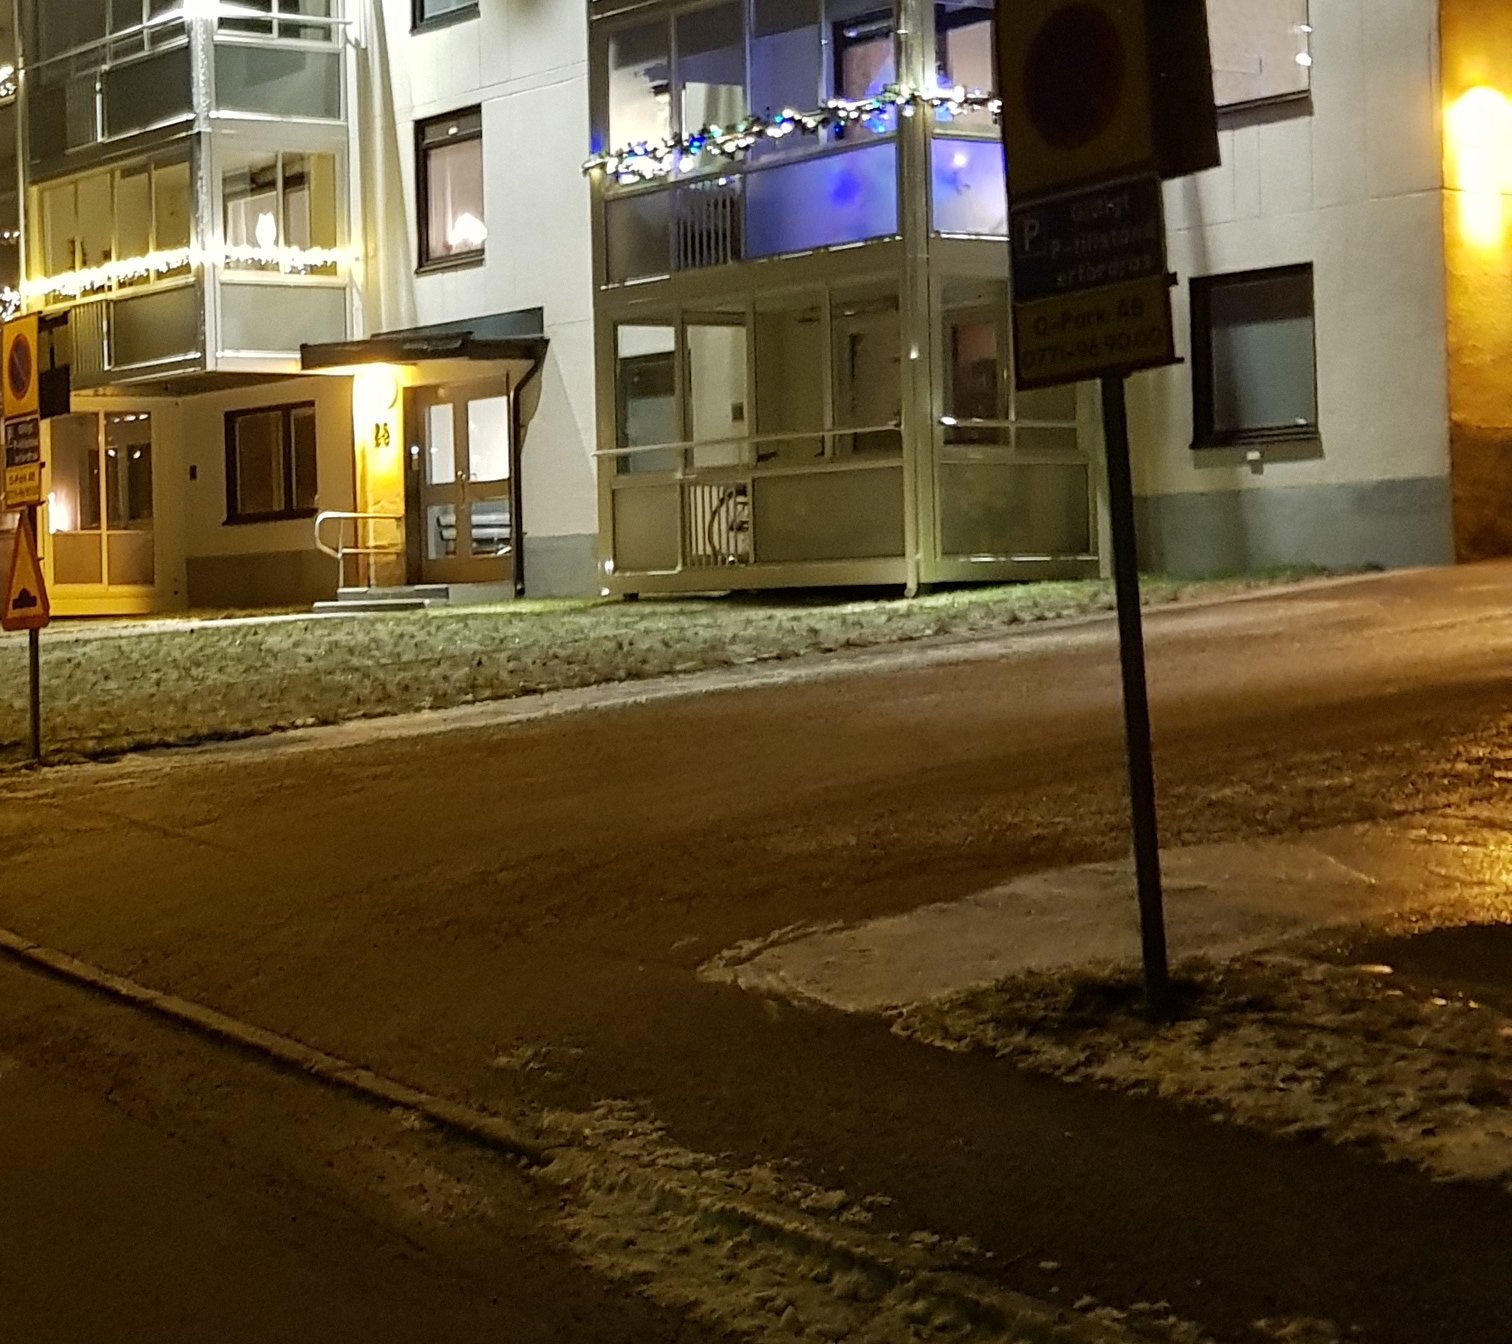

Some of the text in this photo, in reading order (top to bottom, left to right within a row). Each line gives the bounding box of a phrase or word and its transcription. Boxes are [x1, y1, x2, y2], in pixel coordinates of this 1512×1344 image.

[1024, 219, 1040, 251] P
[1034, 297, 1145, 337] Q-Park AB
